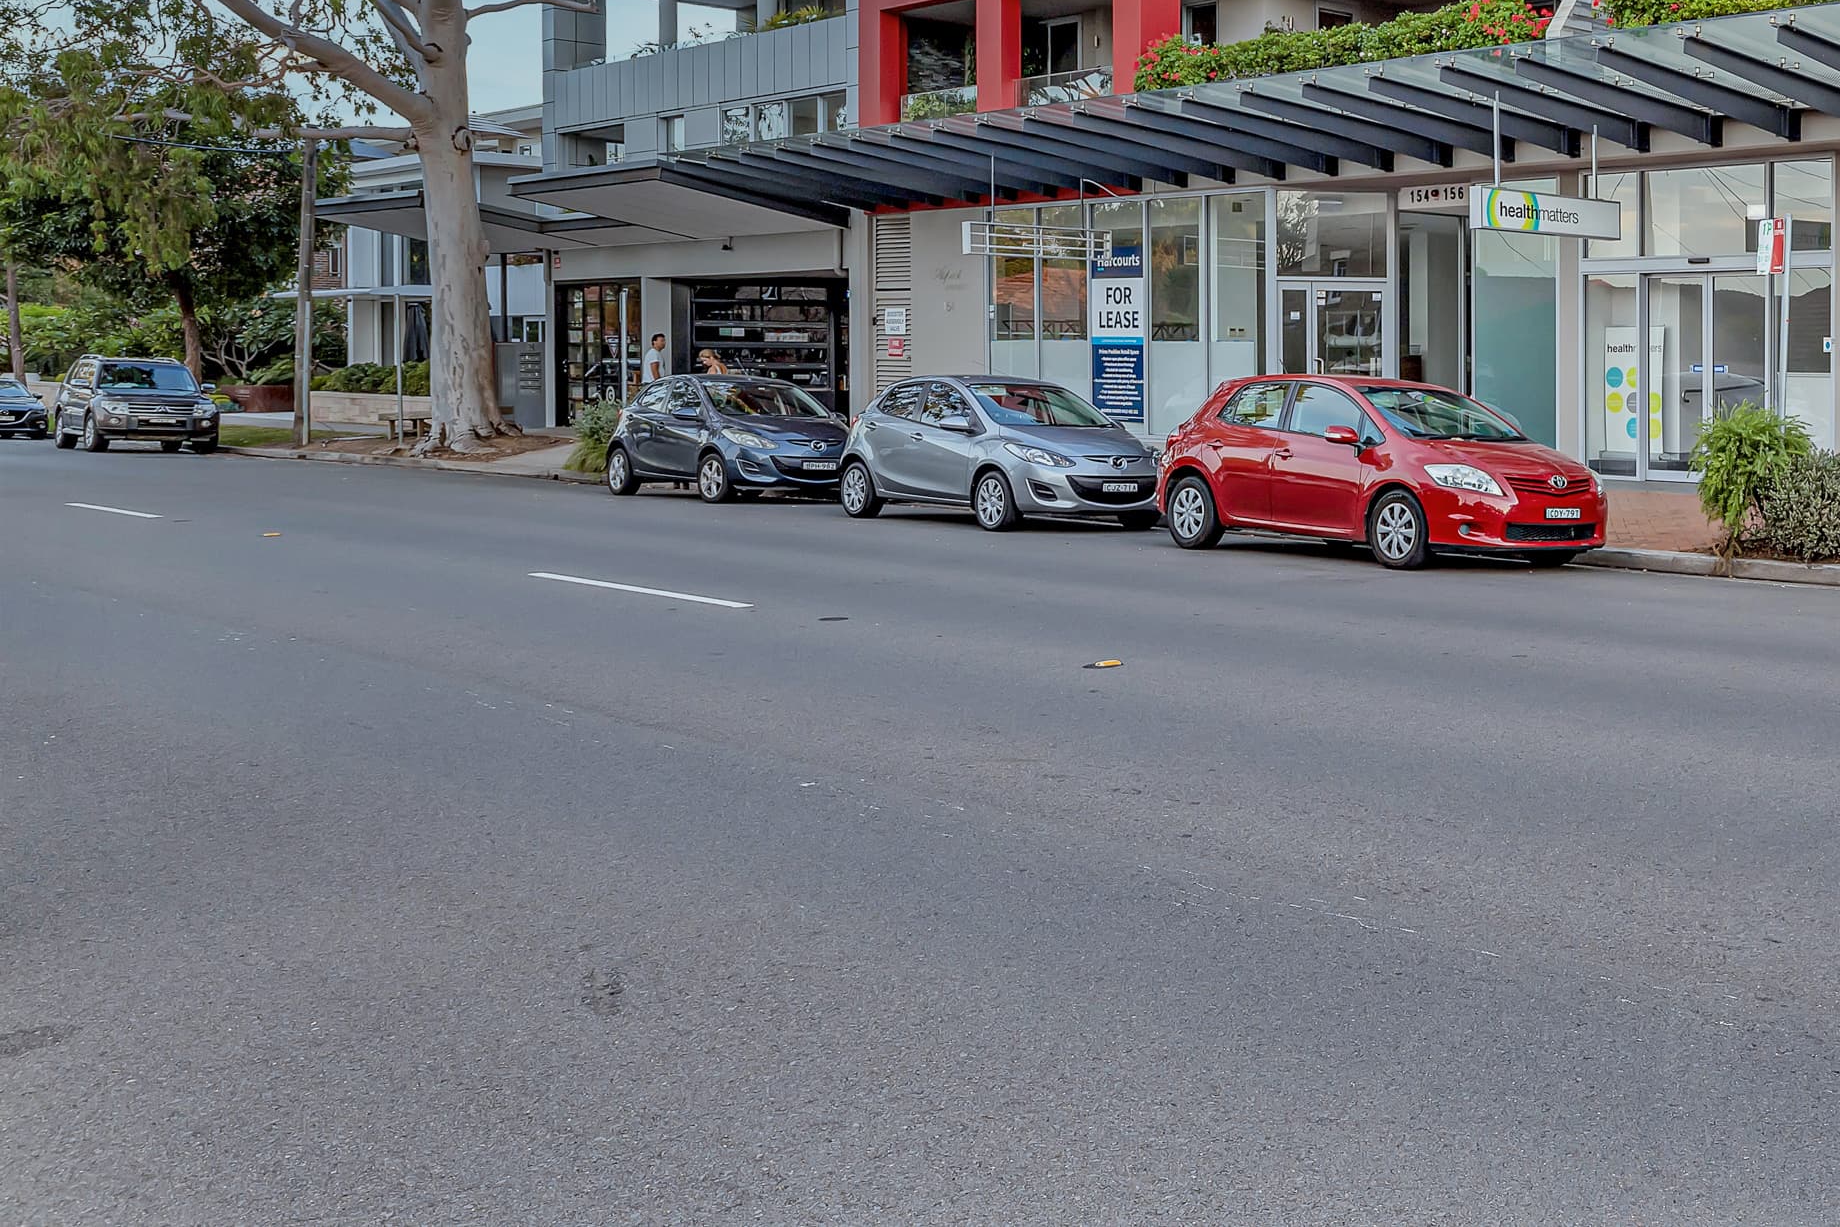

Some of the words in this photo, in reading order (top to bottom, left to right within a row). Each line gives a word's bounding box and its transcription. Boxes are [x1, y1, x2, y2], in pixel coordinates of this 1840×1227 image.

[1410, 189, 1429, 203] 154
[1443, 187, 1464, 201] 156
[1499, 201, 1579, 224] healthmatters
[1106, 287, 1132, 304] FOR
[1099, 311, 1139, 329] LEASE
